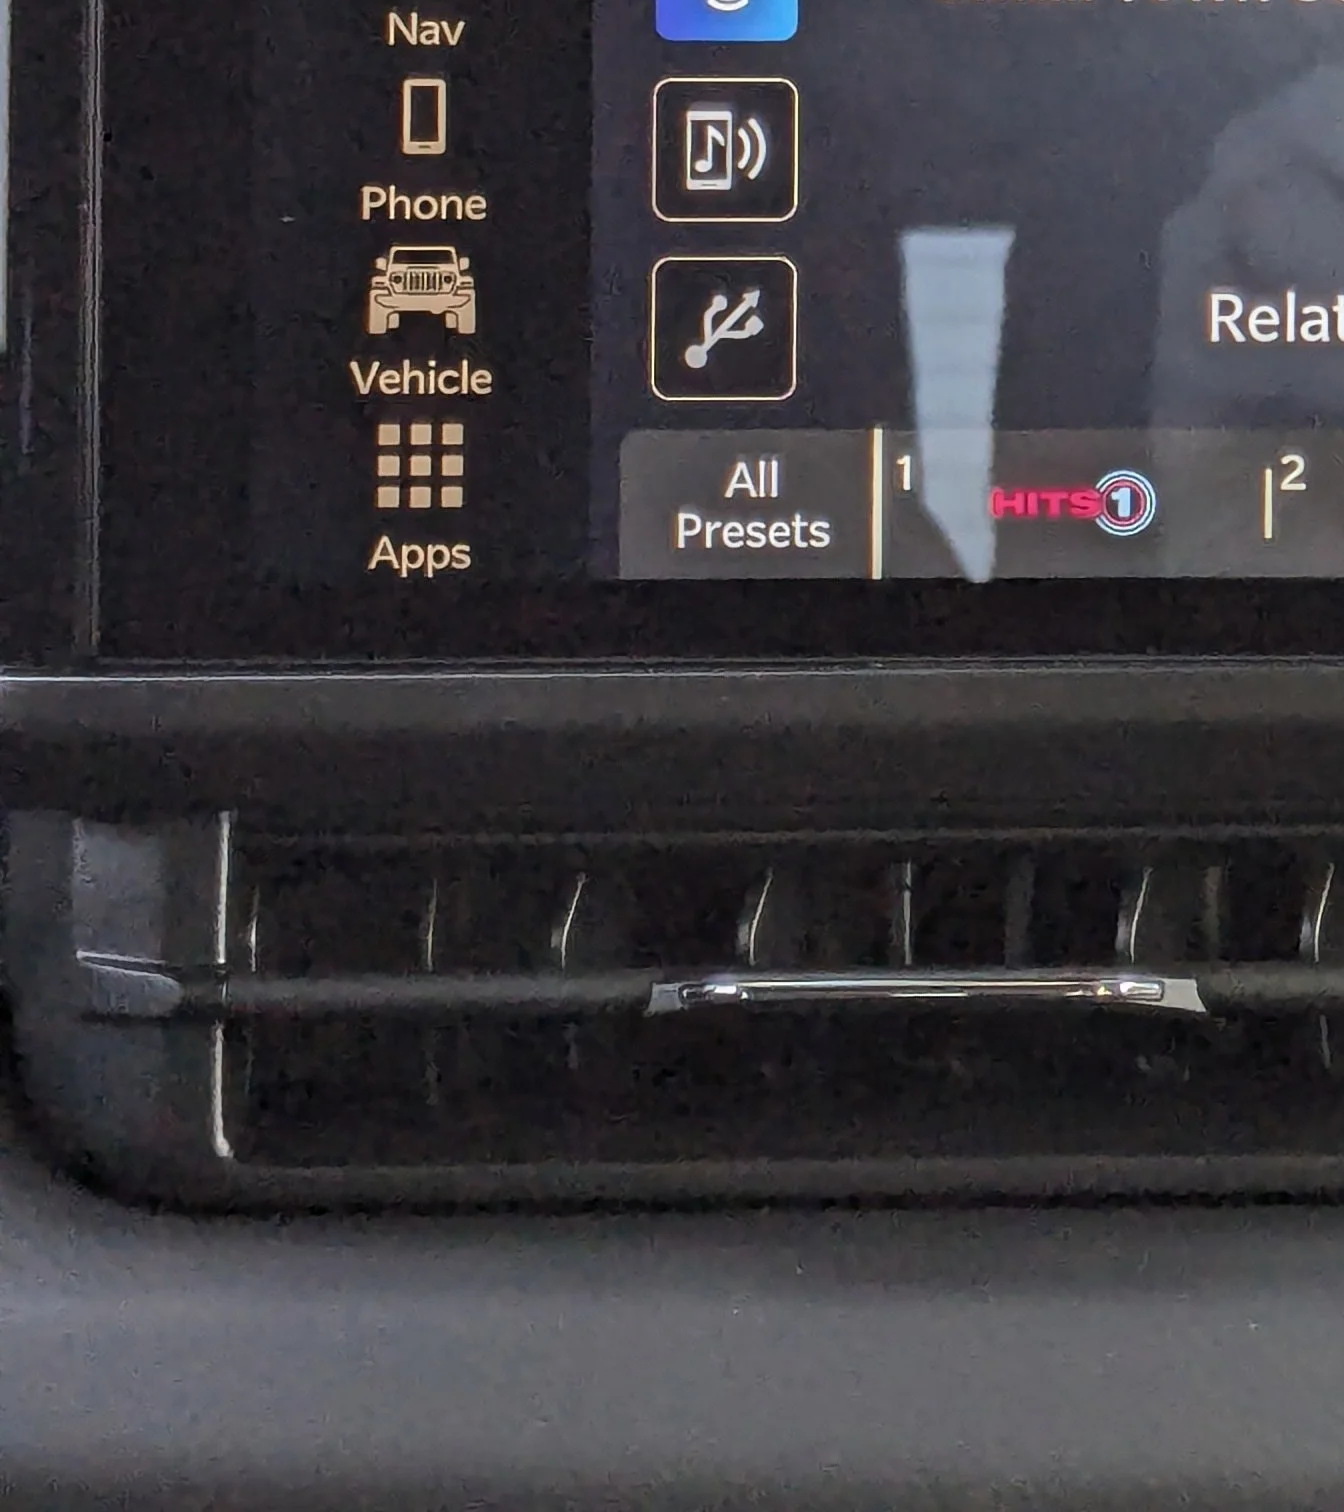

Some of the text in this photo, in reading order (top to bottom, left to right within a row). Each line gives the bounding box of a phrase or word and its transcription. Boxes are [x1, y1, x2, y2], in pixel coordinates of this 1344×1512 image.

[387, 13, 465, 46] Nav
[361, 187, 488, 221] Phone
[350, 362, 493, 397] Vehicle
[724, 461, 778, 499] All
[896, 456, 913, 491] 1
[1281, 456, 1306, 491] 2
[676, 512, 831, 551] Presets
[368, 536, 471, 577] Apps
